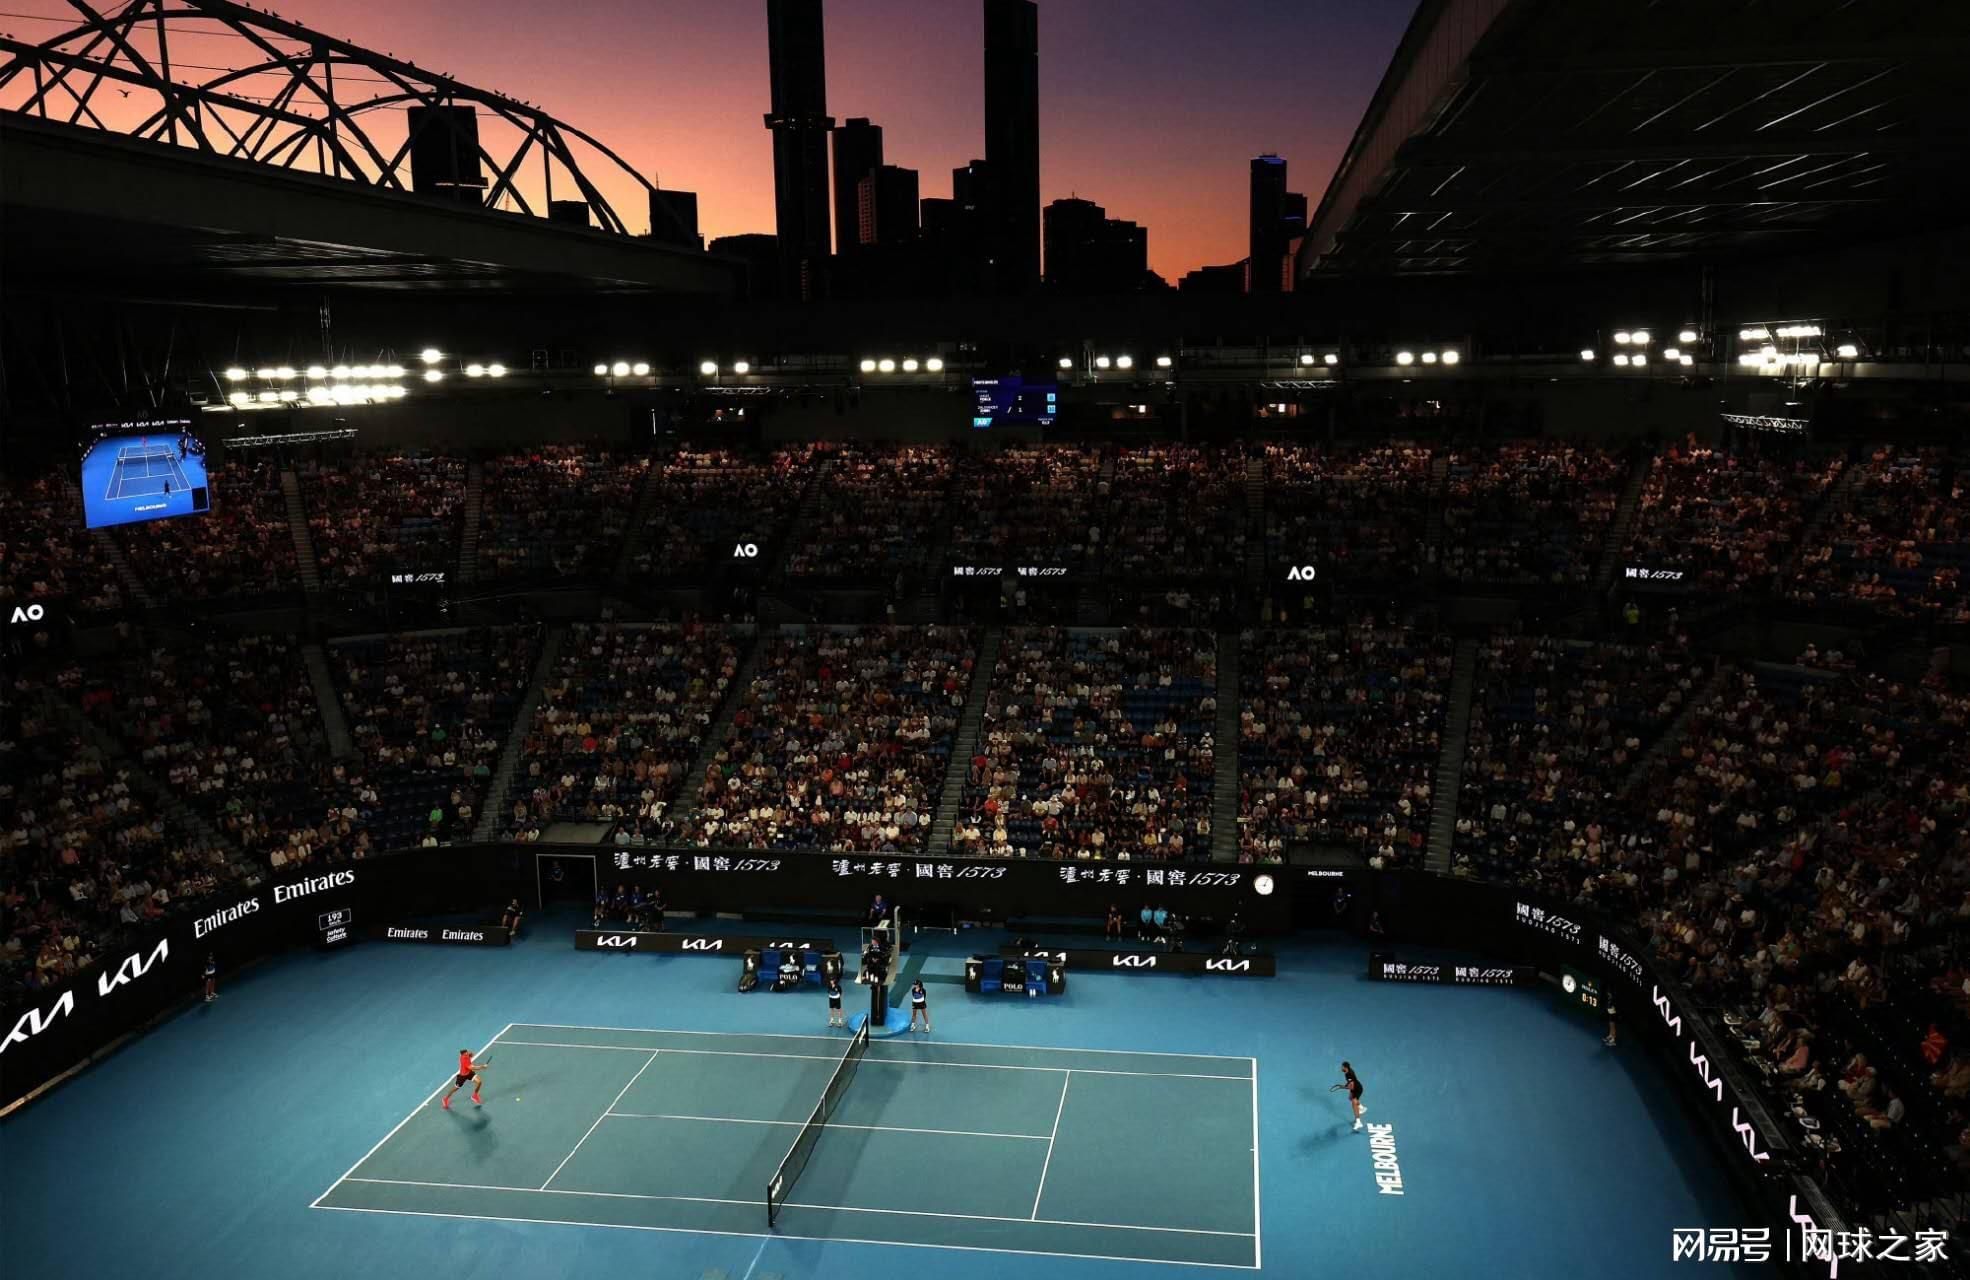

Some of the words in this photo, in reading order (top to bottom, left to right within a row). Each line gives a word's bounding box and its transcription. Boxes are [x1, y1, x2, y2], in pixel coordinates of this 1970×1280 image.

[733, 543, 759, 558] AO
[1287, 565, 1316, 581] AO
[10, 604, 45, 624] AO
[273, 868, 355, 904] Emirates
[193, 897, 260, 939] Emirates
[387, 927, 429, 939] Emirates
[441, 929, 484, 941] Emirates
[596, 935, 637, 947] KIA
[681, 938, 723, 950] KIA
[97, 938, 169, 997] KIA
[1112, 954, 1157, 968] KIA
[1205, 958, 1250, 972] KIA
[1652, 985, 1682, 1037] KIA
[1689, 1041, 1723, 1102] KIA
[1366, 1122, 1405, 1195] MELBOURNE
